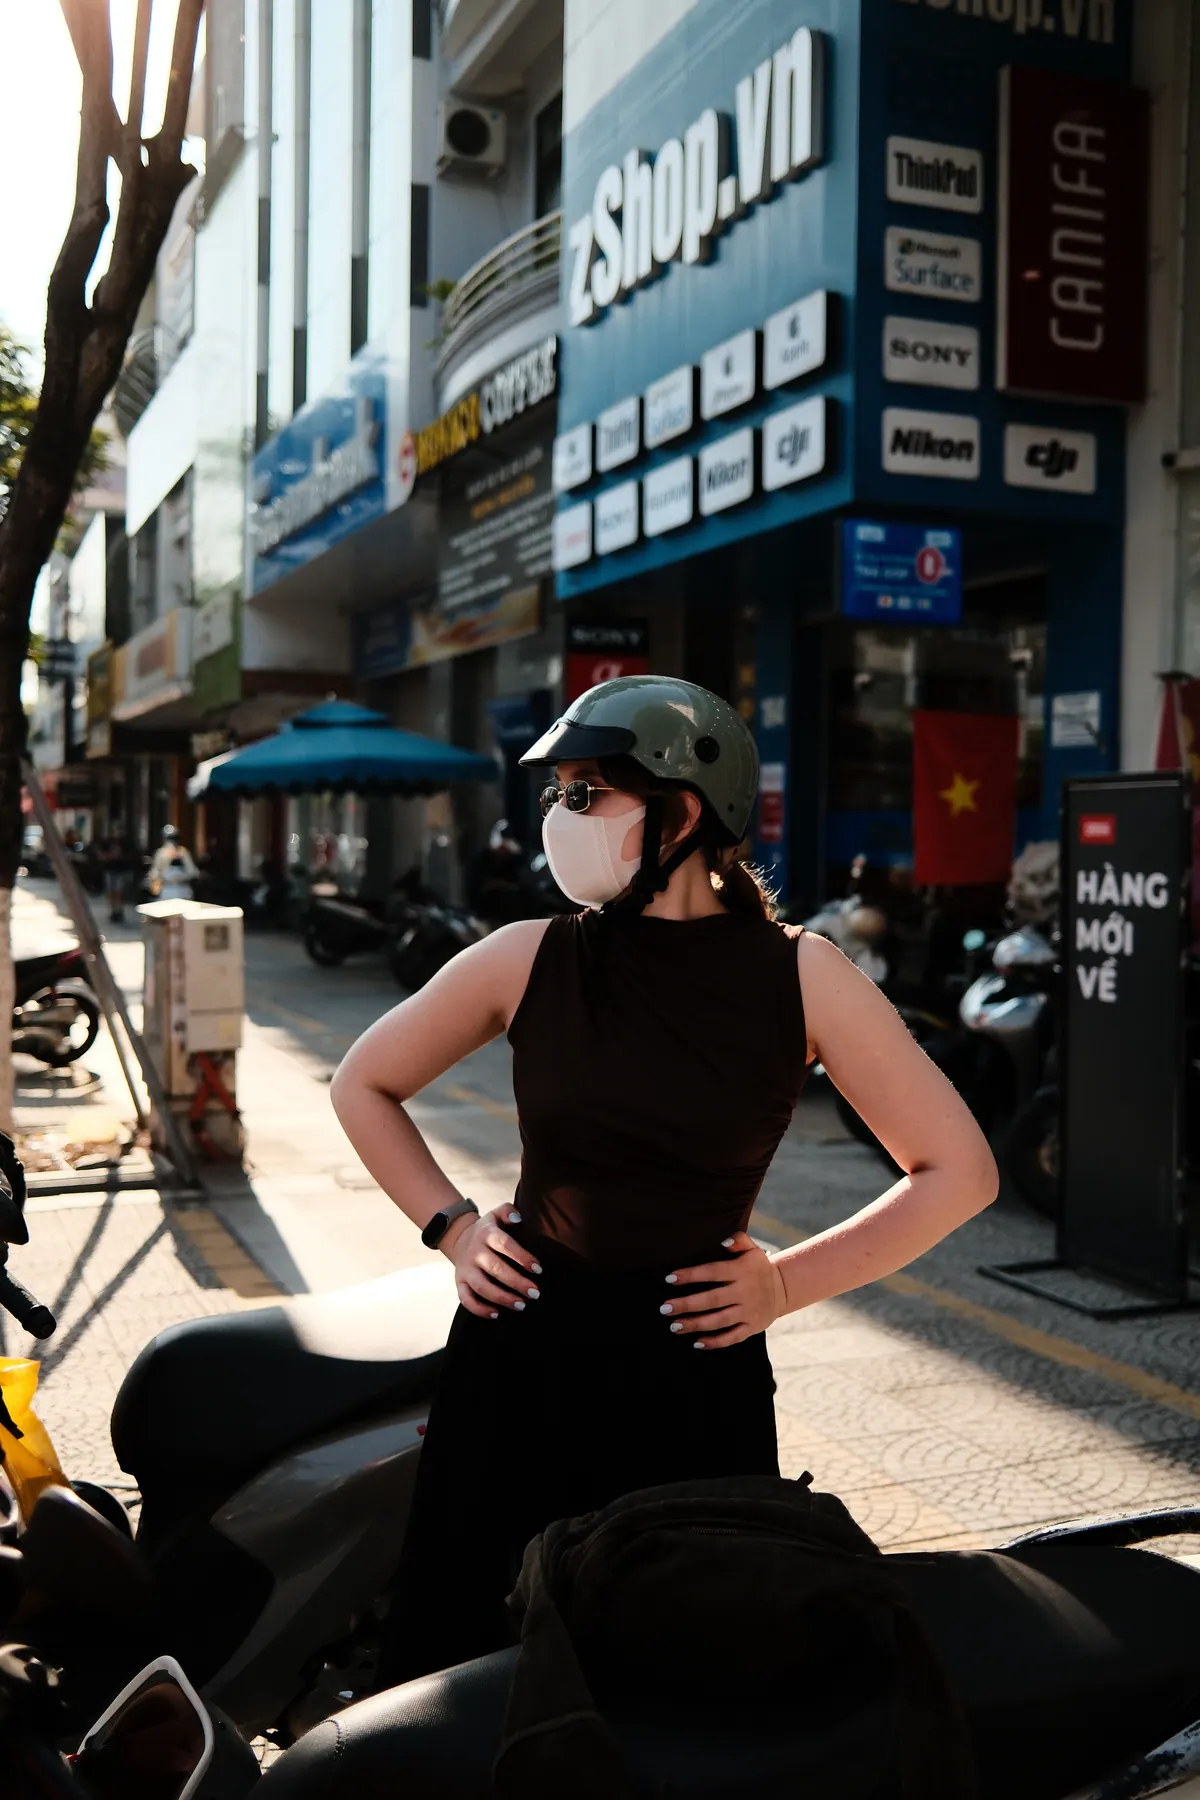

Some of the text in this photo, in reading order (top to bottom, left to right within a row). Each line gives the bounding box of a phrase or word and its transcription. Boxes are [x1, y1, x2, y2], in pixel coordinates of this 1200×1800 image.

[568, 26, 813, 328] zShop.vn
[893, 152, 978, 198] ThinkPad
[1050, 121, 1106, 350] CANIFA
[894, 257, 975, 292] Surface
[890, 338, 972, 367] SONY
[891, 431, 976, 462] Nikon
[1075, 861, 1169, 909] HÀNG
[1075, 910, 1134, 957] MỚI
[1076, 956, 1119, 1003] VỀ
